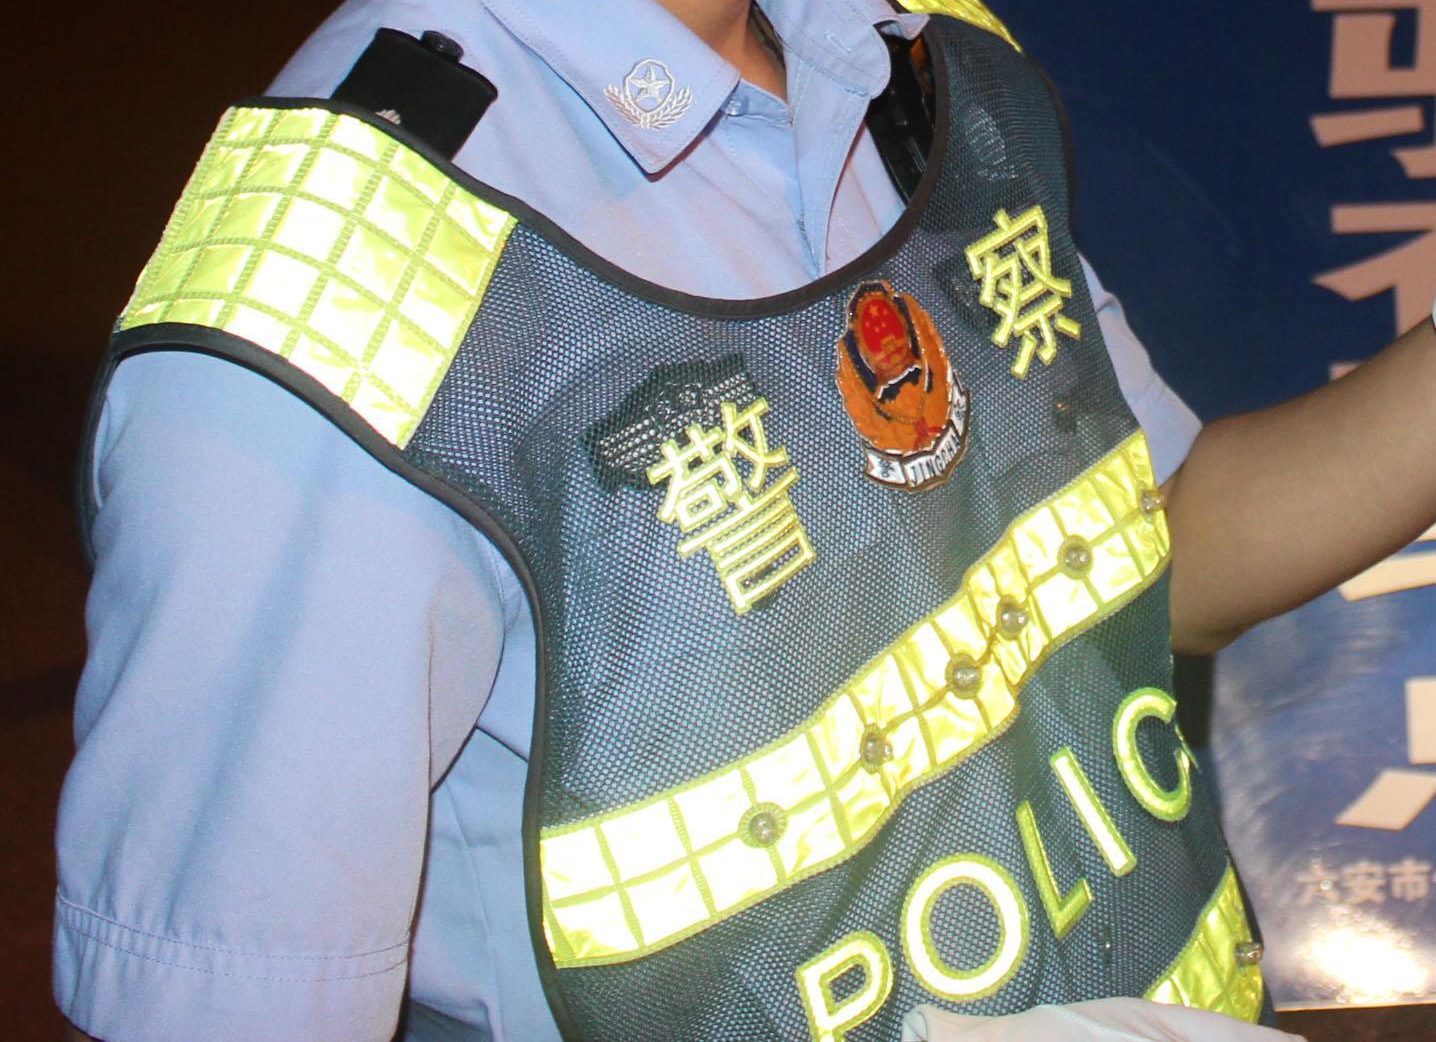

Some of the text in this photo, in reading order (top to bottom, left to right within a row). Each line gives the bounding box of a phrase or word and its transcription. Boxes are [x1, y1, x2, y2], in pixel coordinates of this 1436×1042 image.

[646, 205, 1082, 615] 警 察
[795, 687, 1200, 1042] POLIC
